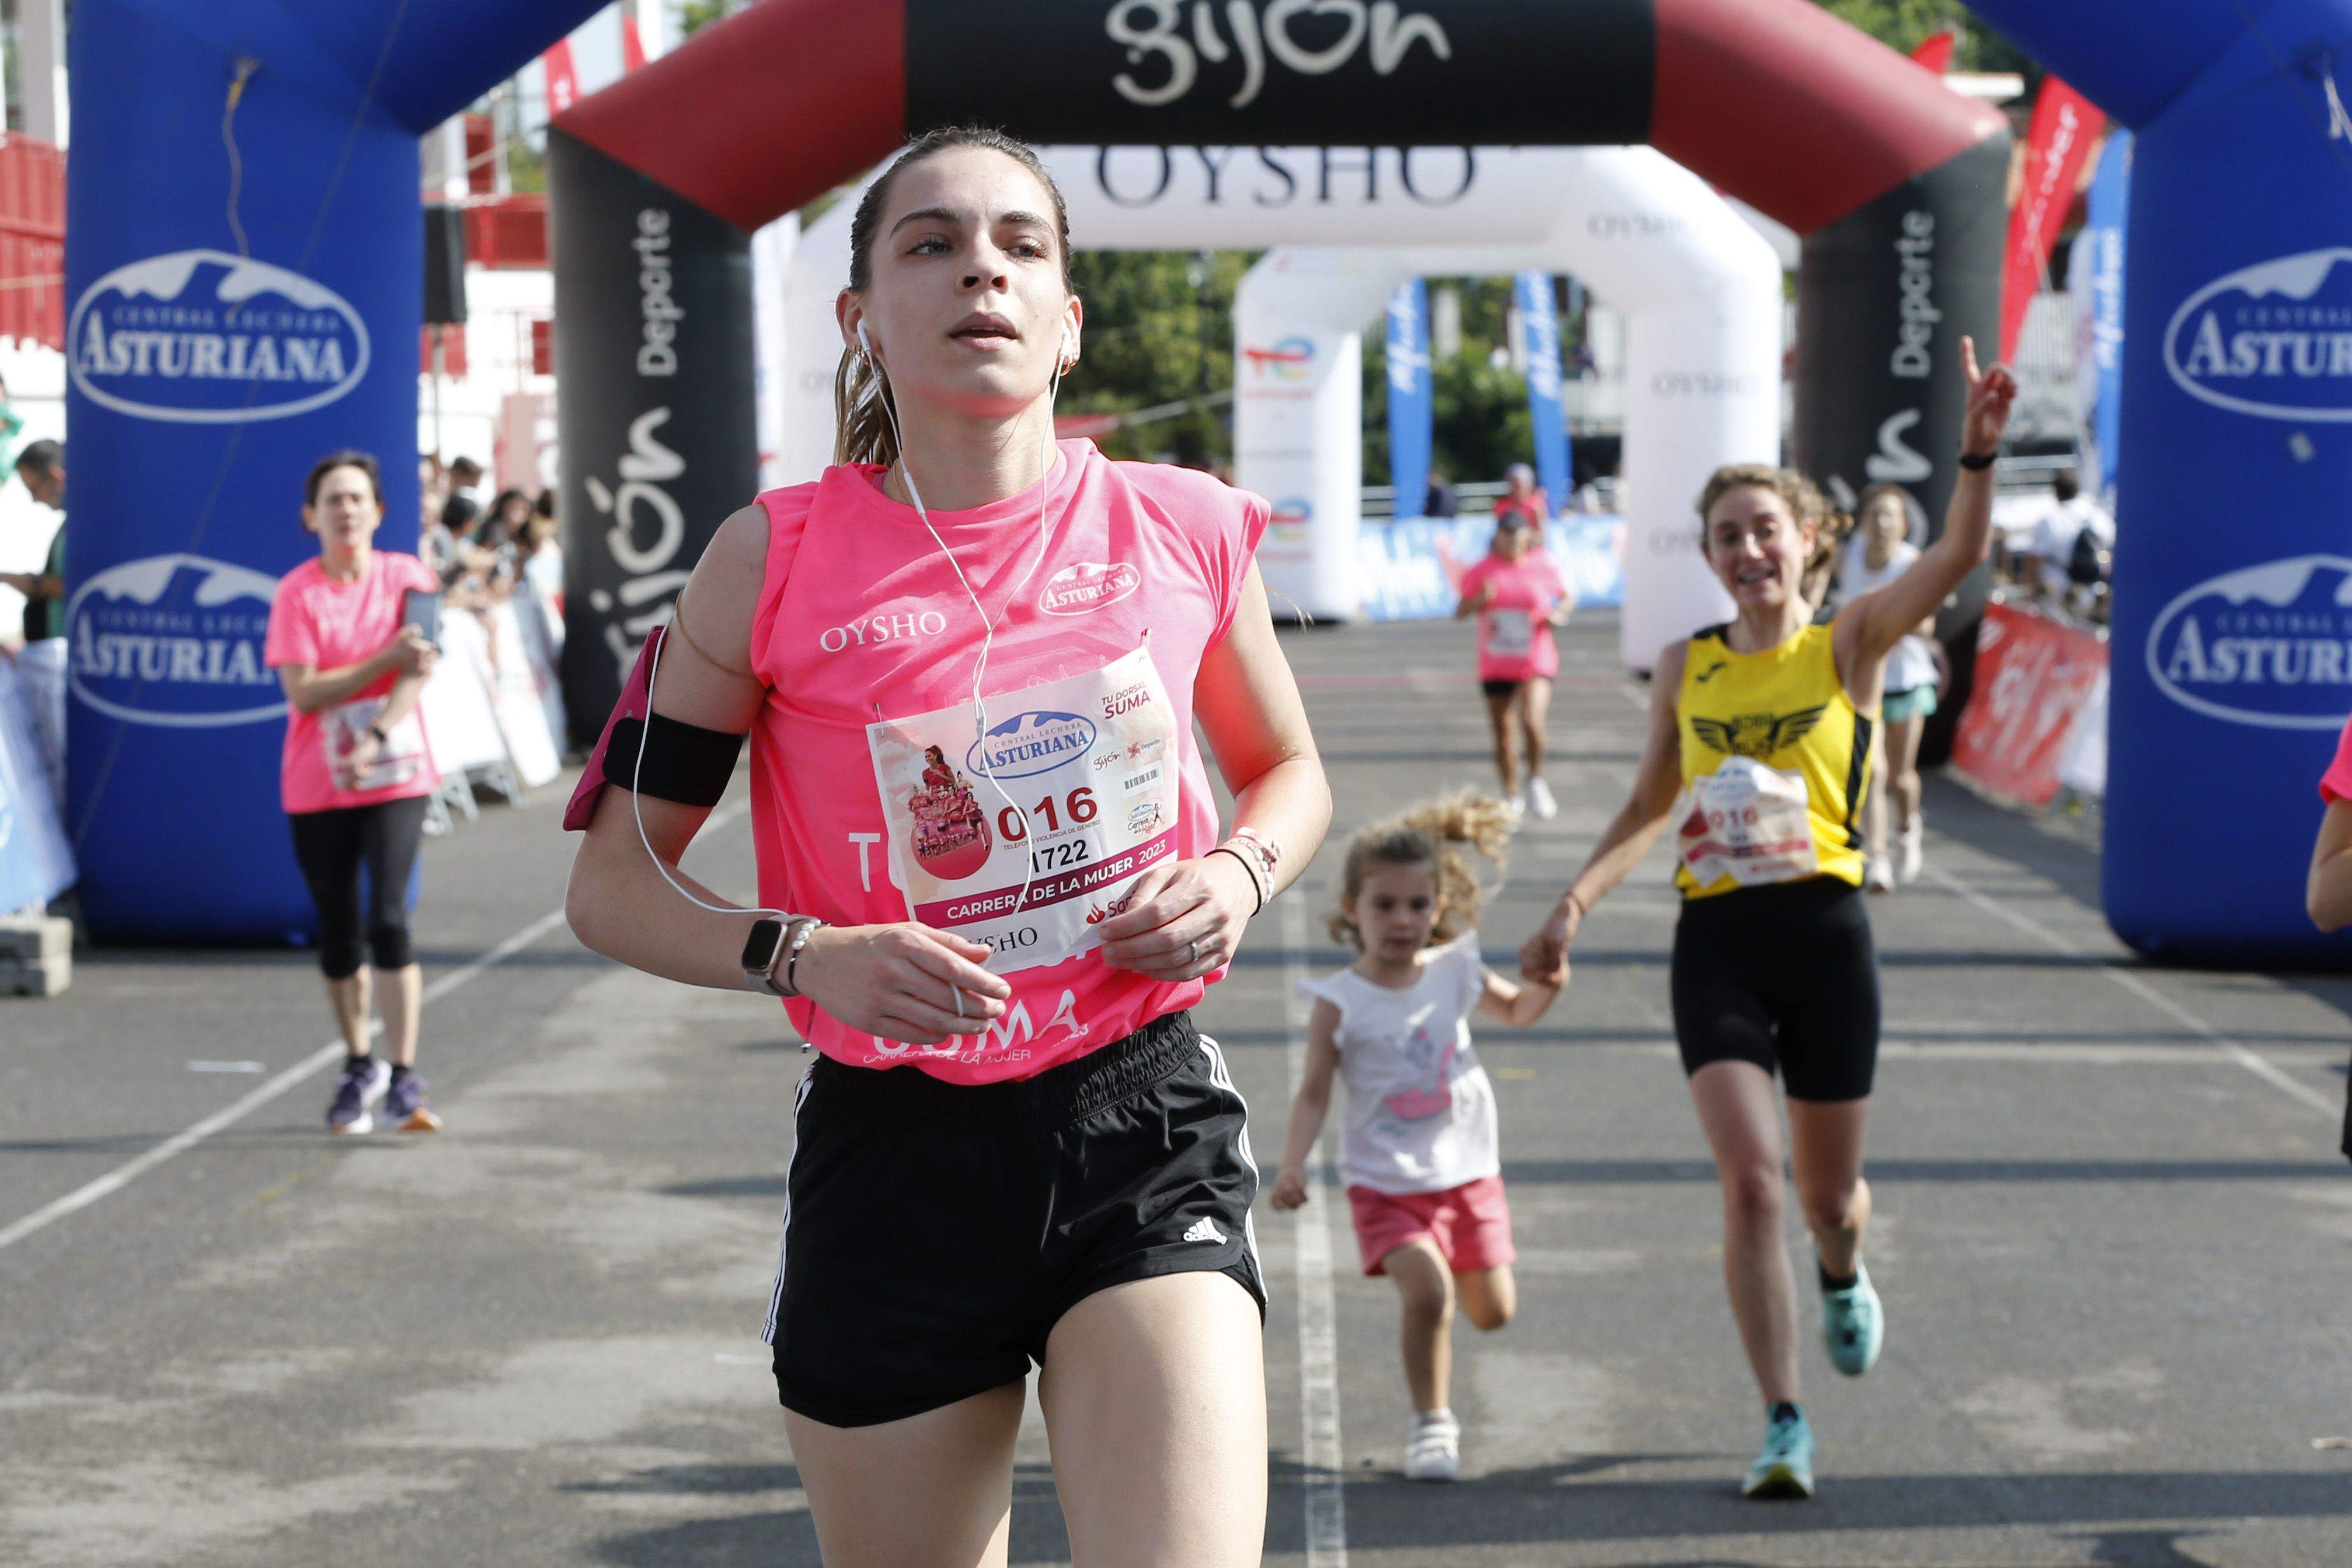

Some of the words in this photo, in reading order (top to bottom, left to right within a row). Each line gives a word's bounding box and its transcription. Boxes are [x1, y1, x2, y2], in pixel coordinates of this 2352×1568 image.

[1095, 145, 1478, 208] OYSHO
[633, 207, 685, 377] Deporte
[1891, 210, 1942, 378] Deporte
[78, 308, 347, 382] ASTURIANA
[1046, 573, 1135, 609] ASTURIANA
[820, 611, 946, 652] OYSHO
[1102, 695, 1113, 705] TU
[1116, 681, 1147, 701] DORSAL
[1104, 690, 1151, 719] SUMA
[978, 730, 1089, 771] ASTURIANA
[994, 734, 1036, 748] CENTRAL
[1039, 722, 1082, 736] LECHERA
[998, 787, 1097, 841] 016
[1027, 839, 1089, 873] 1722
[1036, 831, 1067, 842] VIOLENCIA
[946, 891, 1029, 920] CARRERA
[1033, 885, 1055, 901] DE
[1060, 878, 1081, 894] LA
[1084, 857, 1133, 886] MUJER
[1138, 840, 1166, 865] 2023
[960, 1051, 980, 1065] LA
